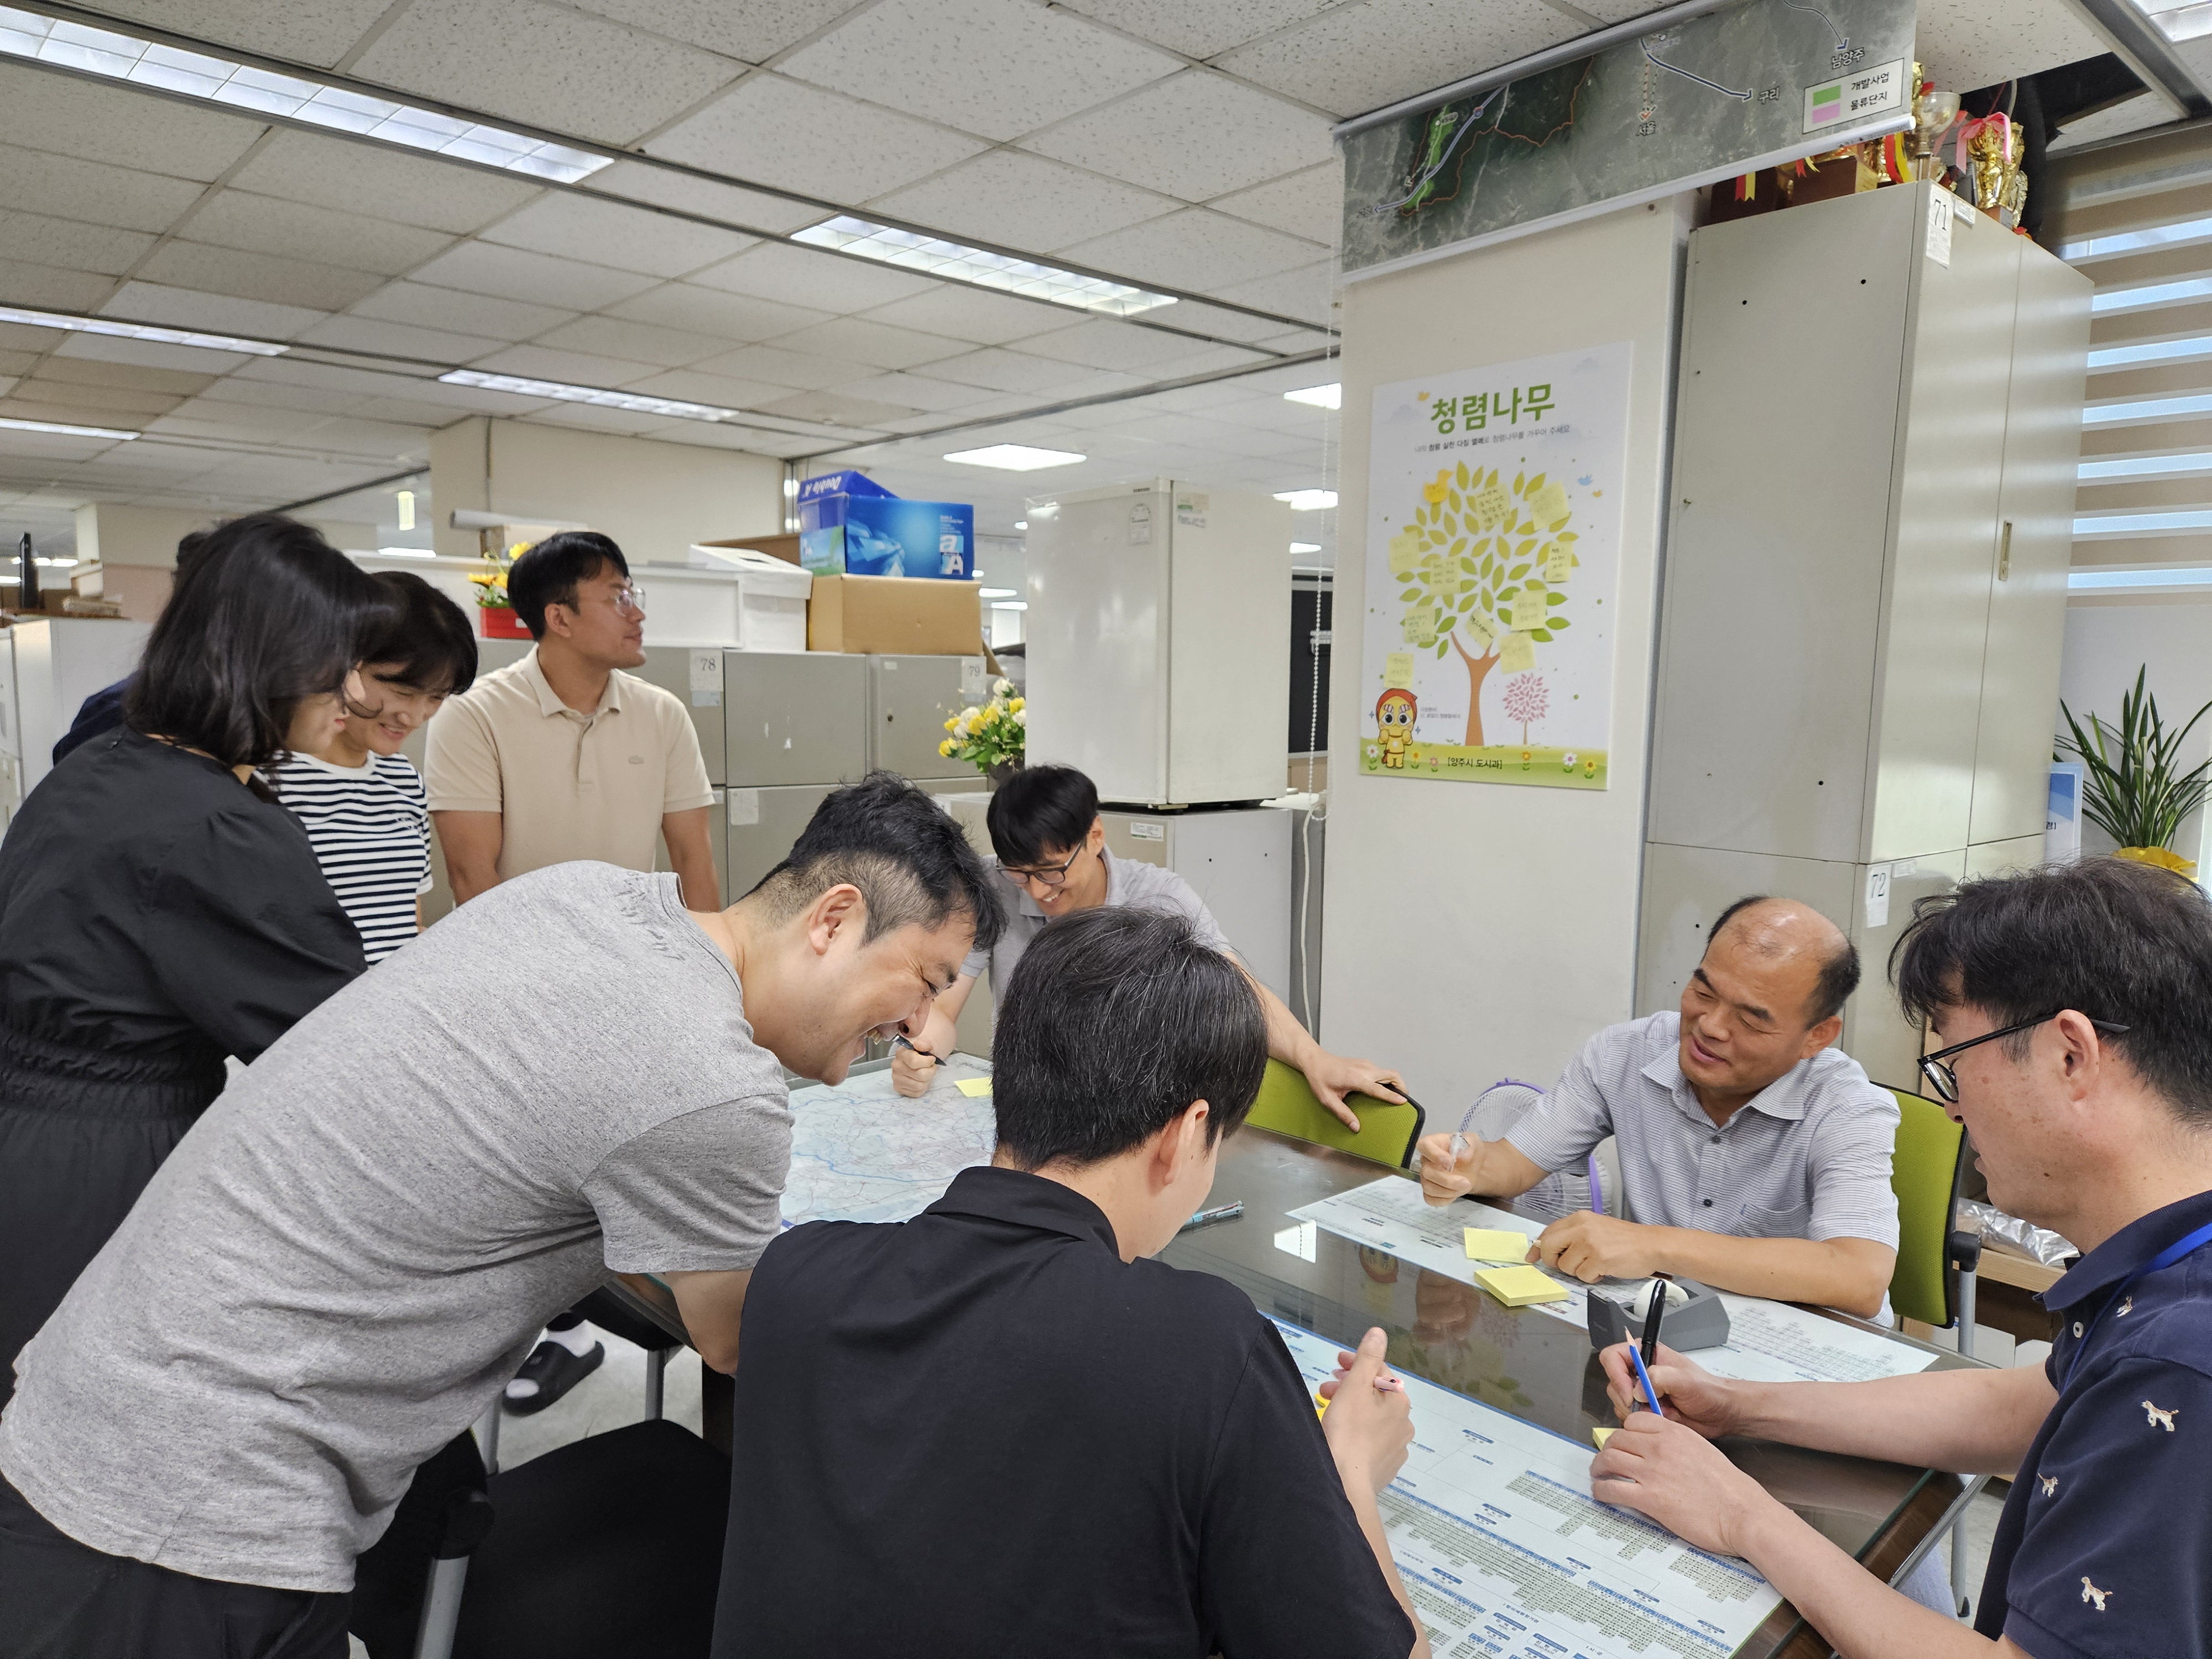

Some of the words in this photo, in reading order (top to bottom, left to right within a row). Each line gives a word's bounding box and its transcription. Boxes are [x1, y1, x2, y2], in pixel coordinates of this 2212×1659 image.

[1831, 48, 1865, 70] 남양주
[1851, 72, 1890, 91] 개발사업
[1758, 85, 1780, 105] 구리
[1850, 91, 1888, 111] 물류단지
[1635, 120, 1657, 137] 서울
[1934, 198, 1947, 231] 71
[1430, 383, 1556, 435] 청렴나무
[1428, 442, 1441, 452] 청렴
[1443, 441, 1455, 450] 실천
[1457, 439, 1469, 447] 다짐
[1527, 427, 1547, 437] 가꾸어
[1550, 424, 1571, 435] 주세요
[812, 475, 842, 494] Double
[701, 656, 716, 671] 78
[969, 665, 980, 677] 79
[1447, 757, 1473, 767] [양주시
[1475, 759, 1503, 769] 도시과]
[1871, 872, 1886, 898] 72
